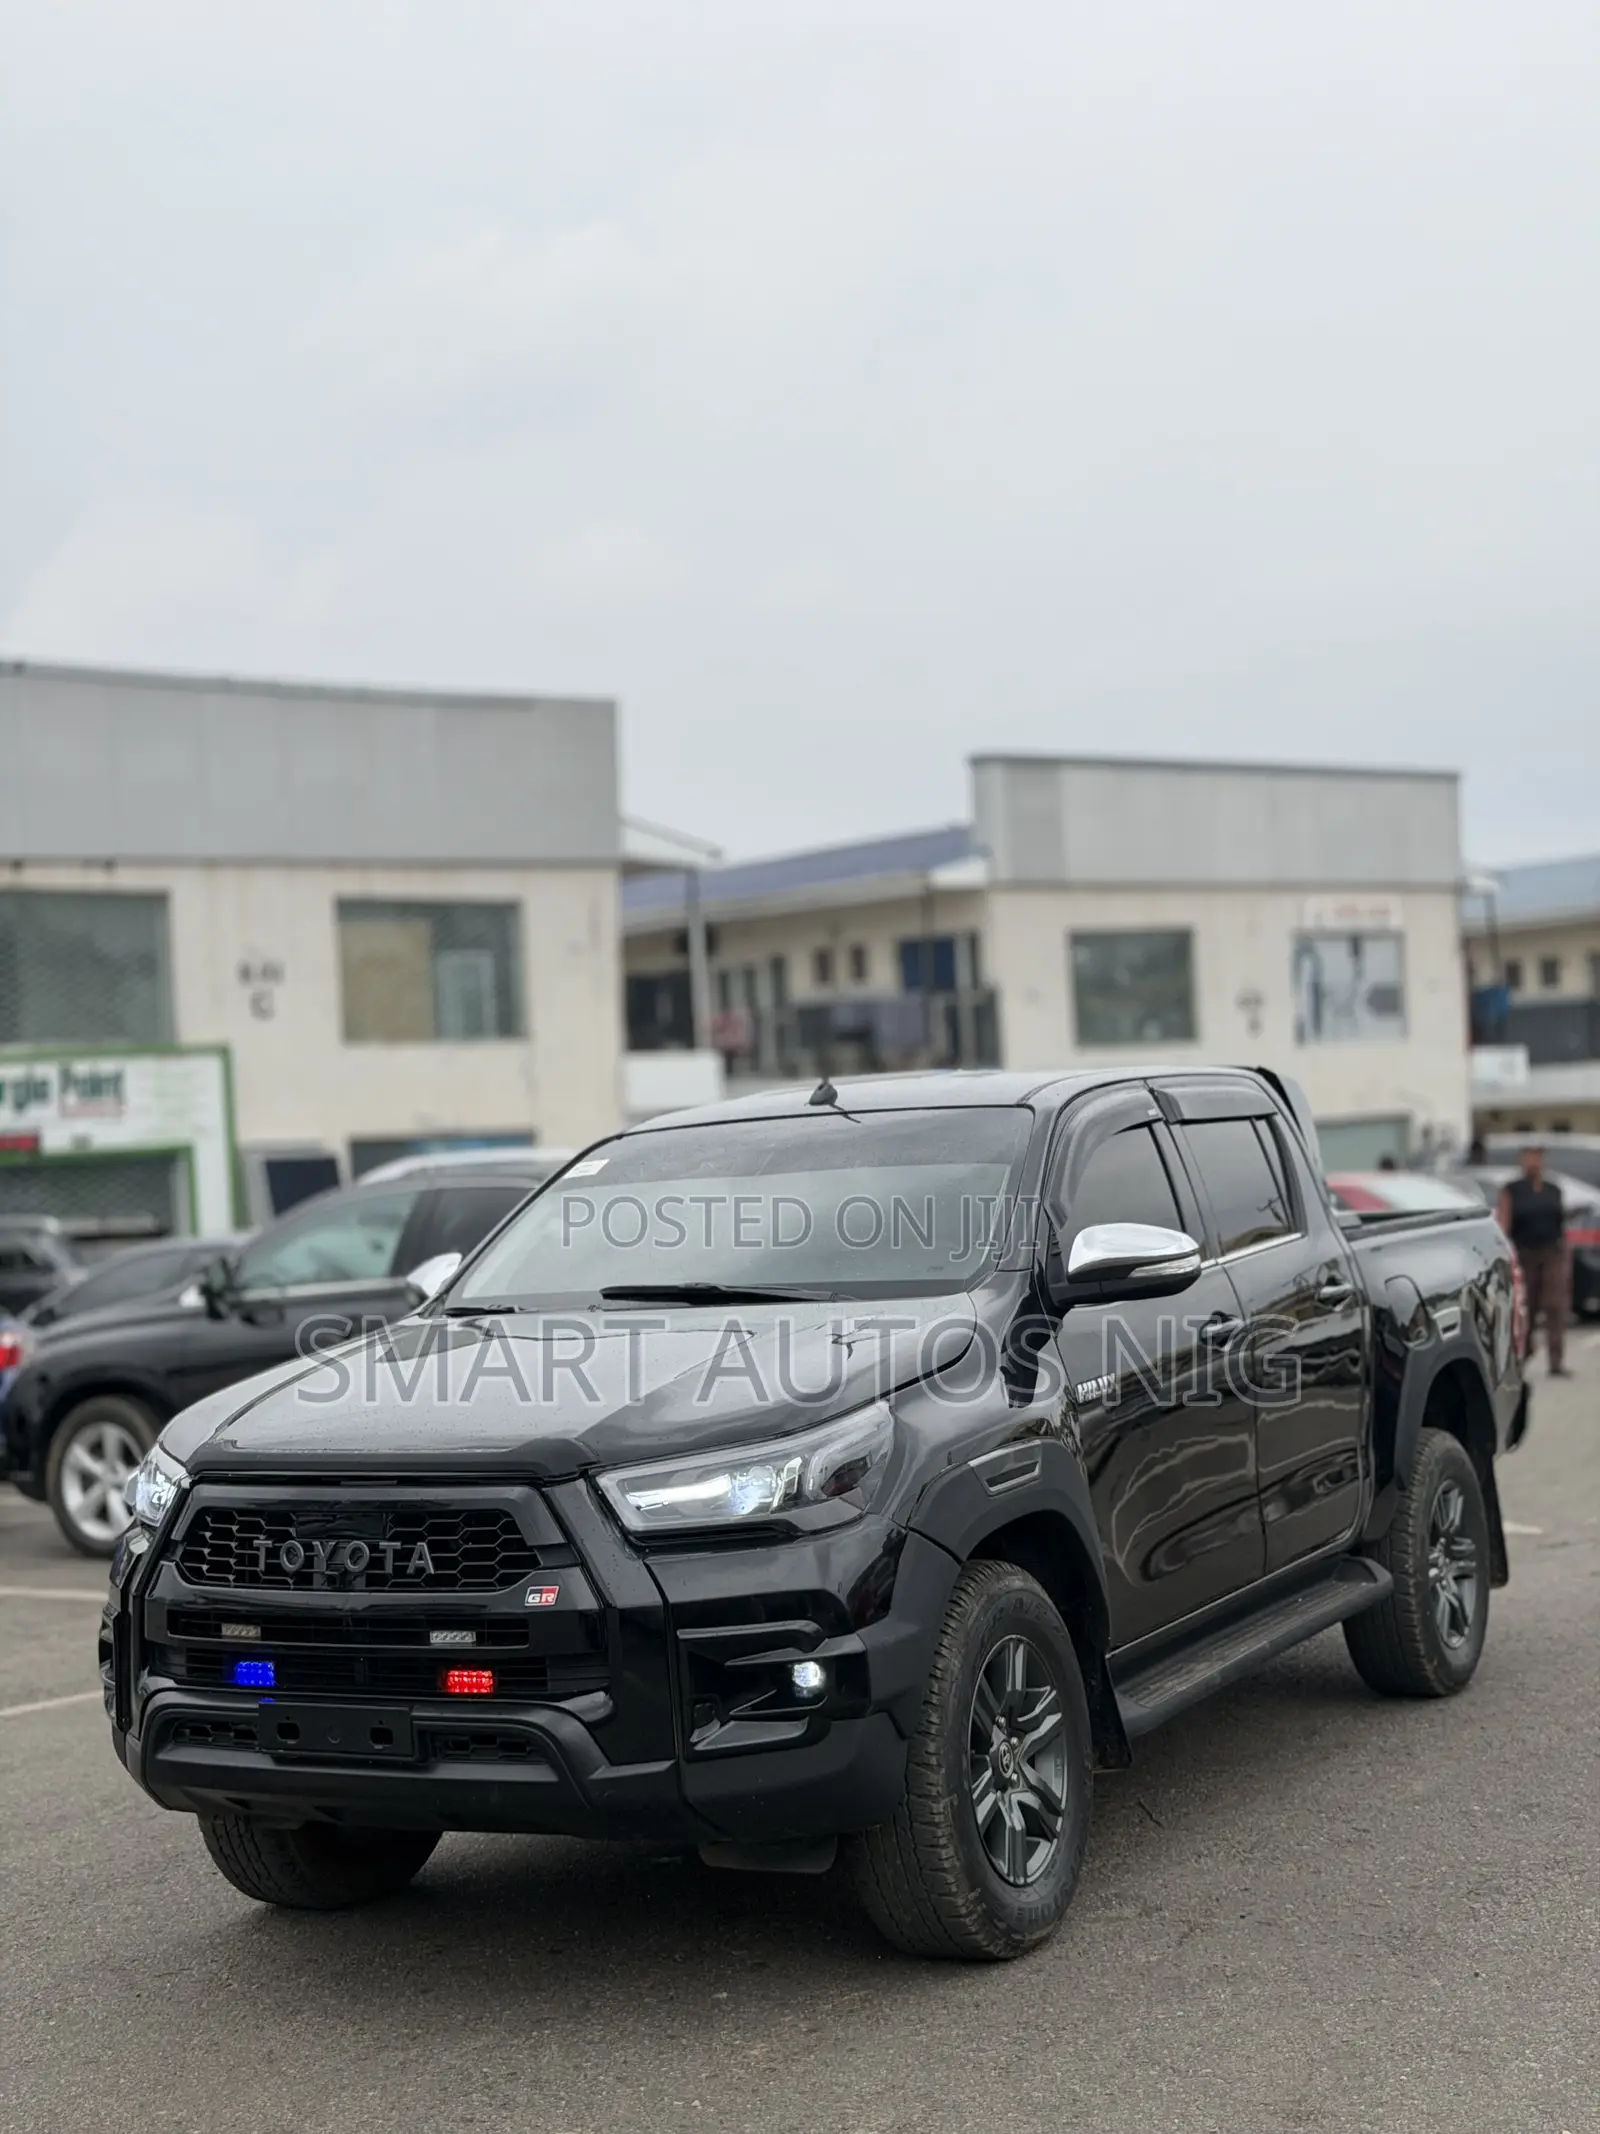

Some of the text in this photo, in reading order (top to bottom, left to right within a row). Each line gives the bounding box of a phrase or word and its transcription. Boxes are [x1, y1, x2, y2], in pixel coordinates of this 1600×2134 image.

[1077, 1372, 1117, 1403] HILUX
[253, 1540, 436, 1575] TOYOTA
[527, 1592, 555, 1604] GR
